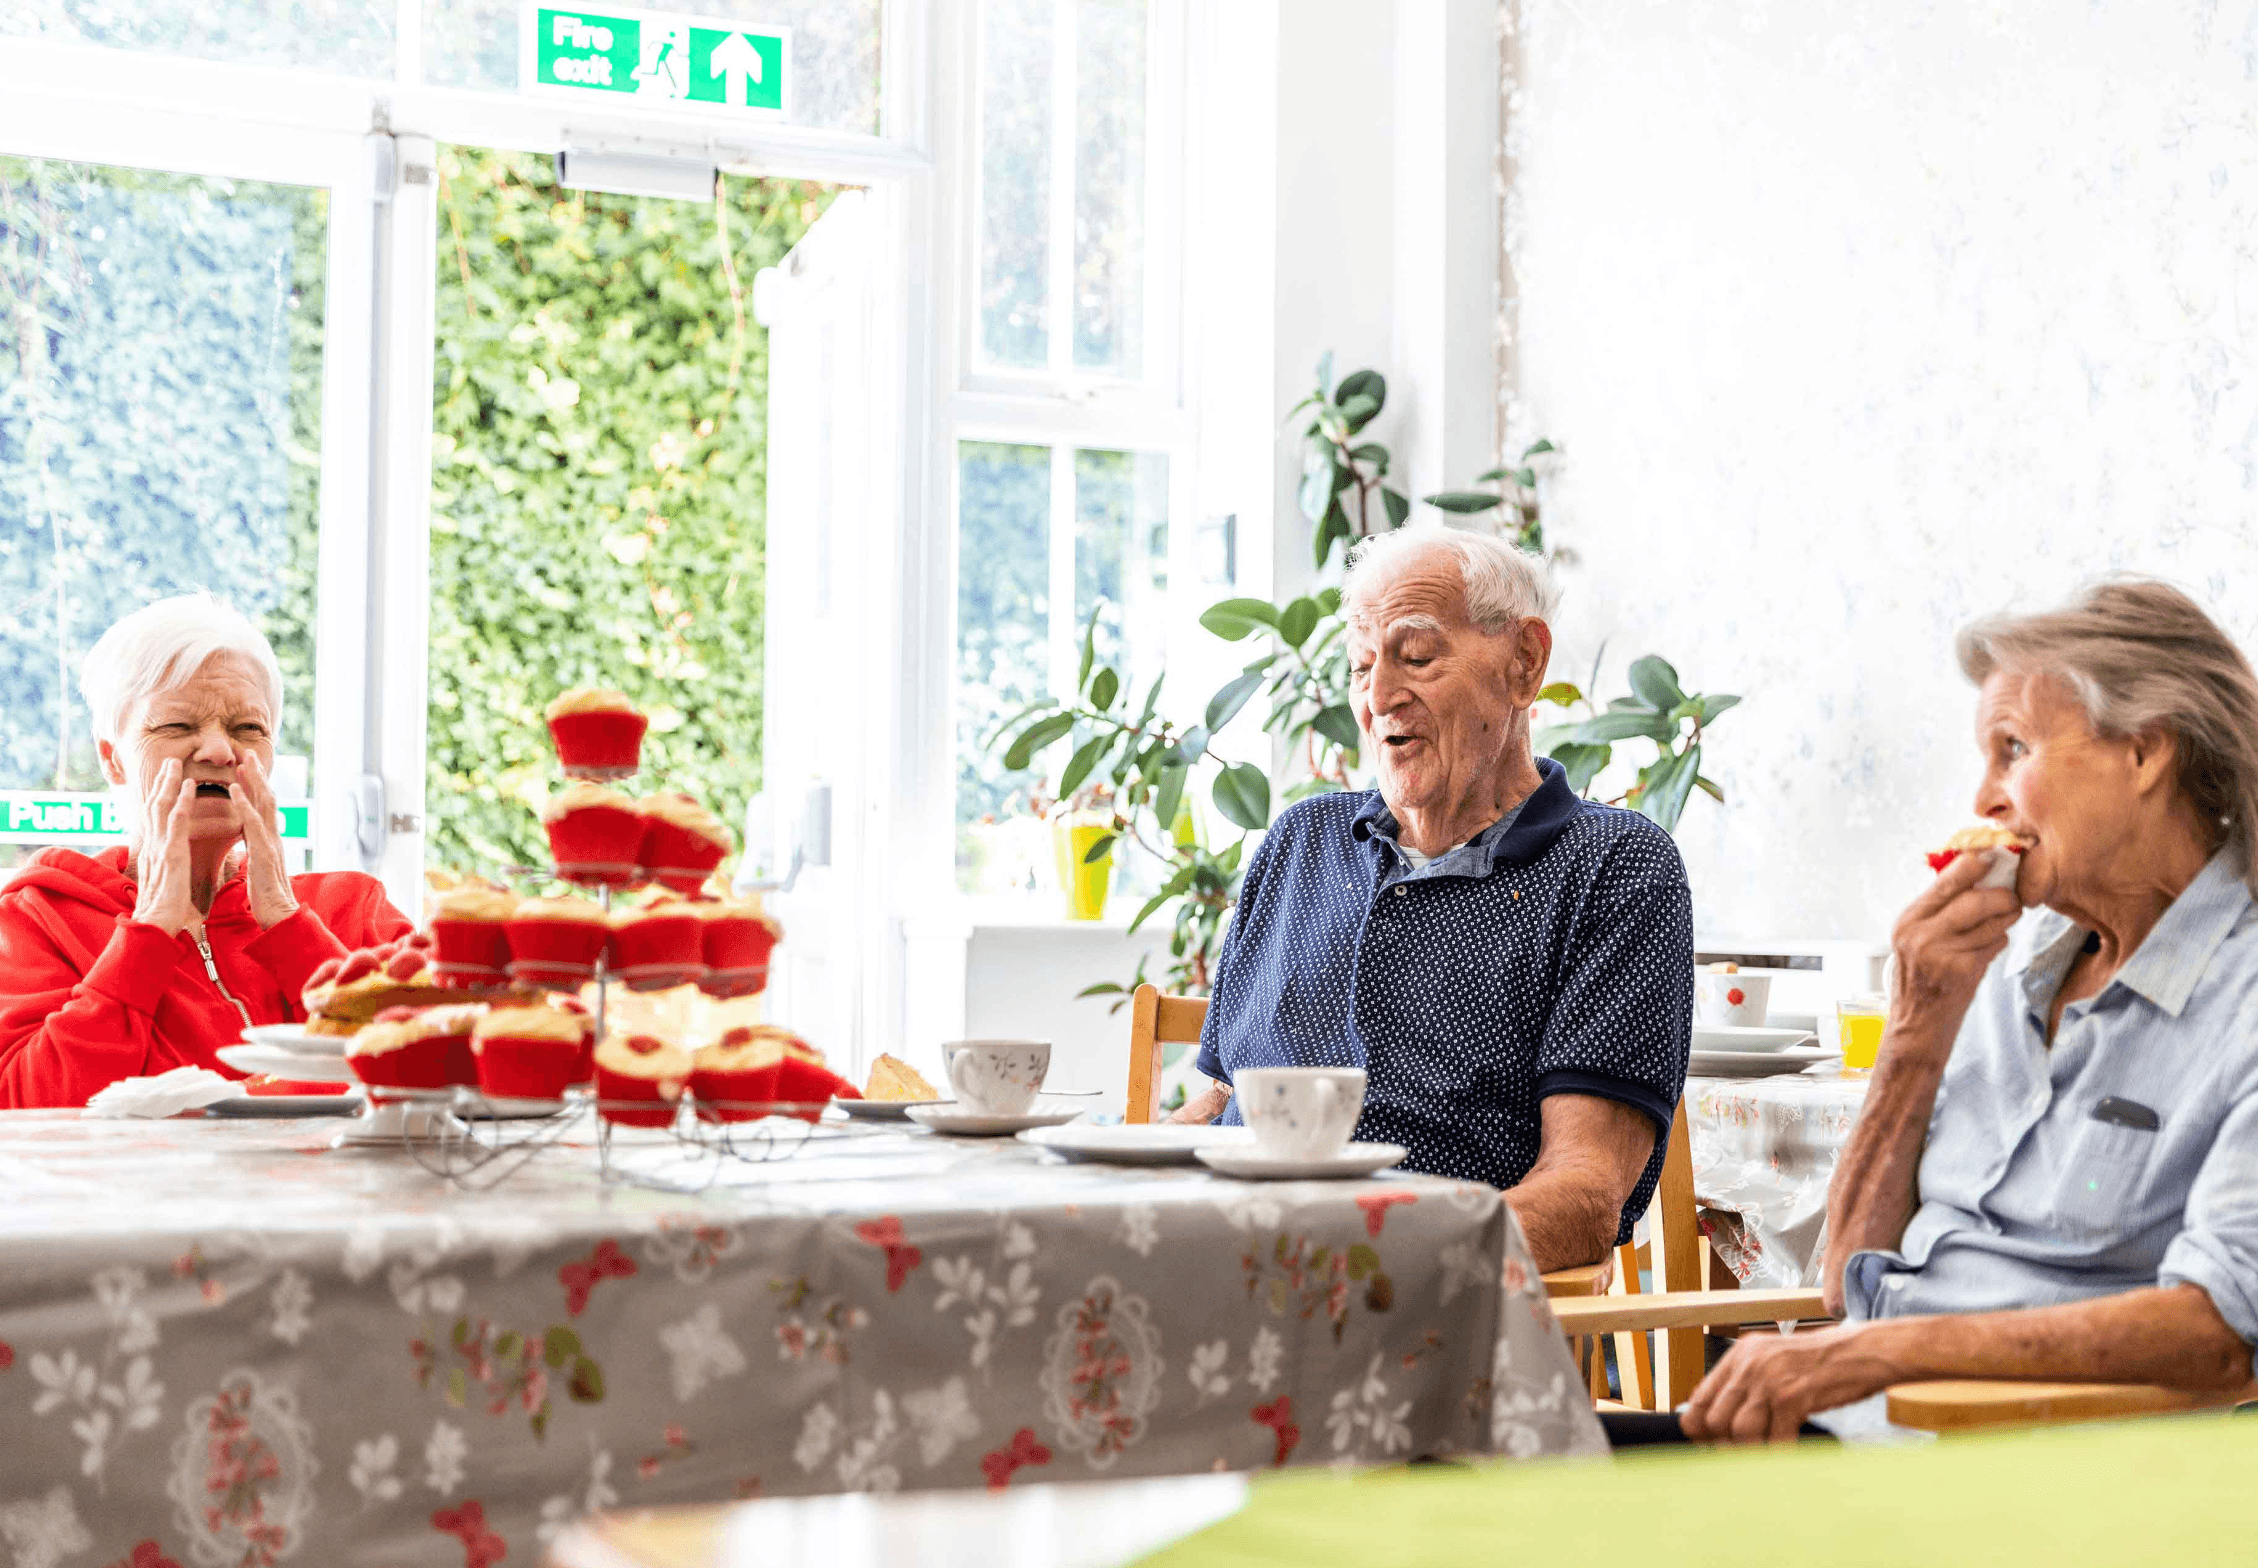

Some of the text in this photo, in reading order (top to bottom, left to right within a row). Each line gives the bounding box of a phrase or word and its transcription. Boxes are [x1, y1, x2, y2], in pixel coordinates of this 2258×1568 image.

[553, 15, 613, 51] Fire
[553, 54, 613, 86] exit
[9, 800, 94, 831] Push
